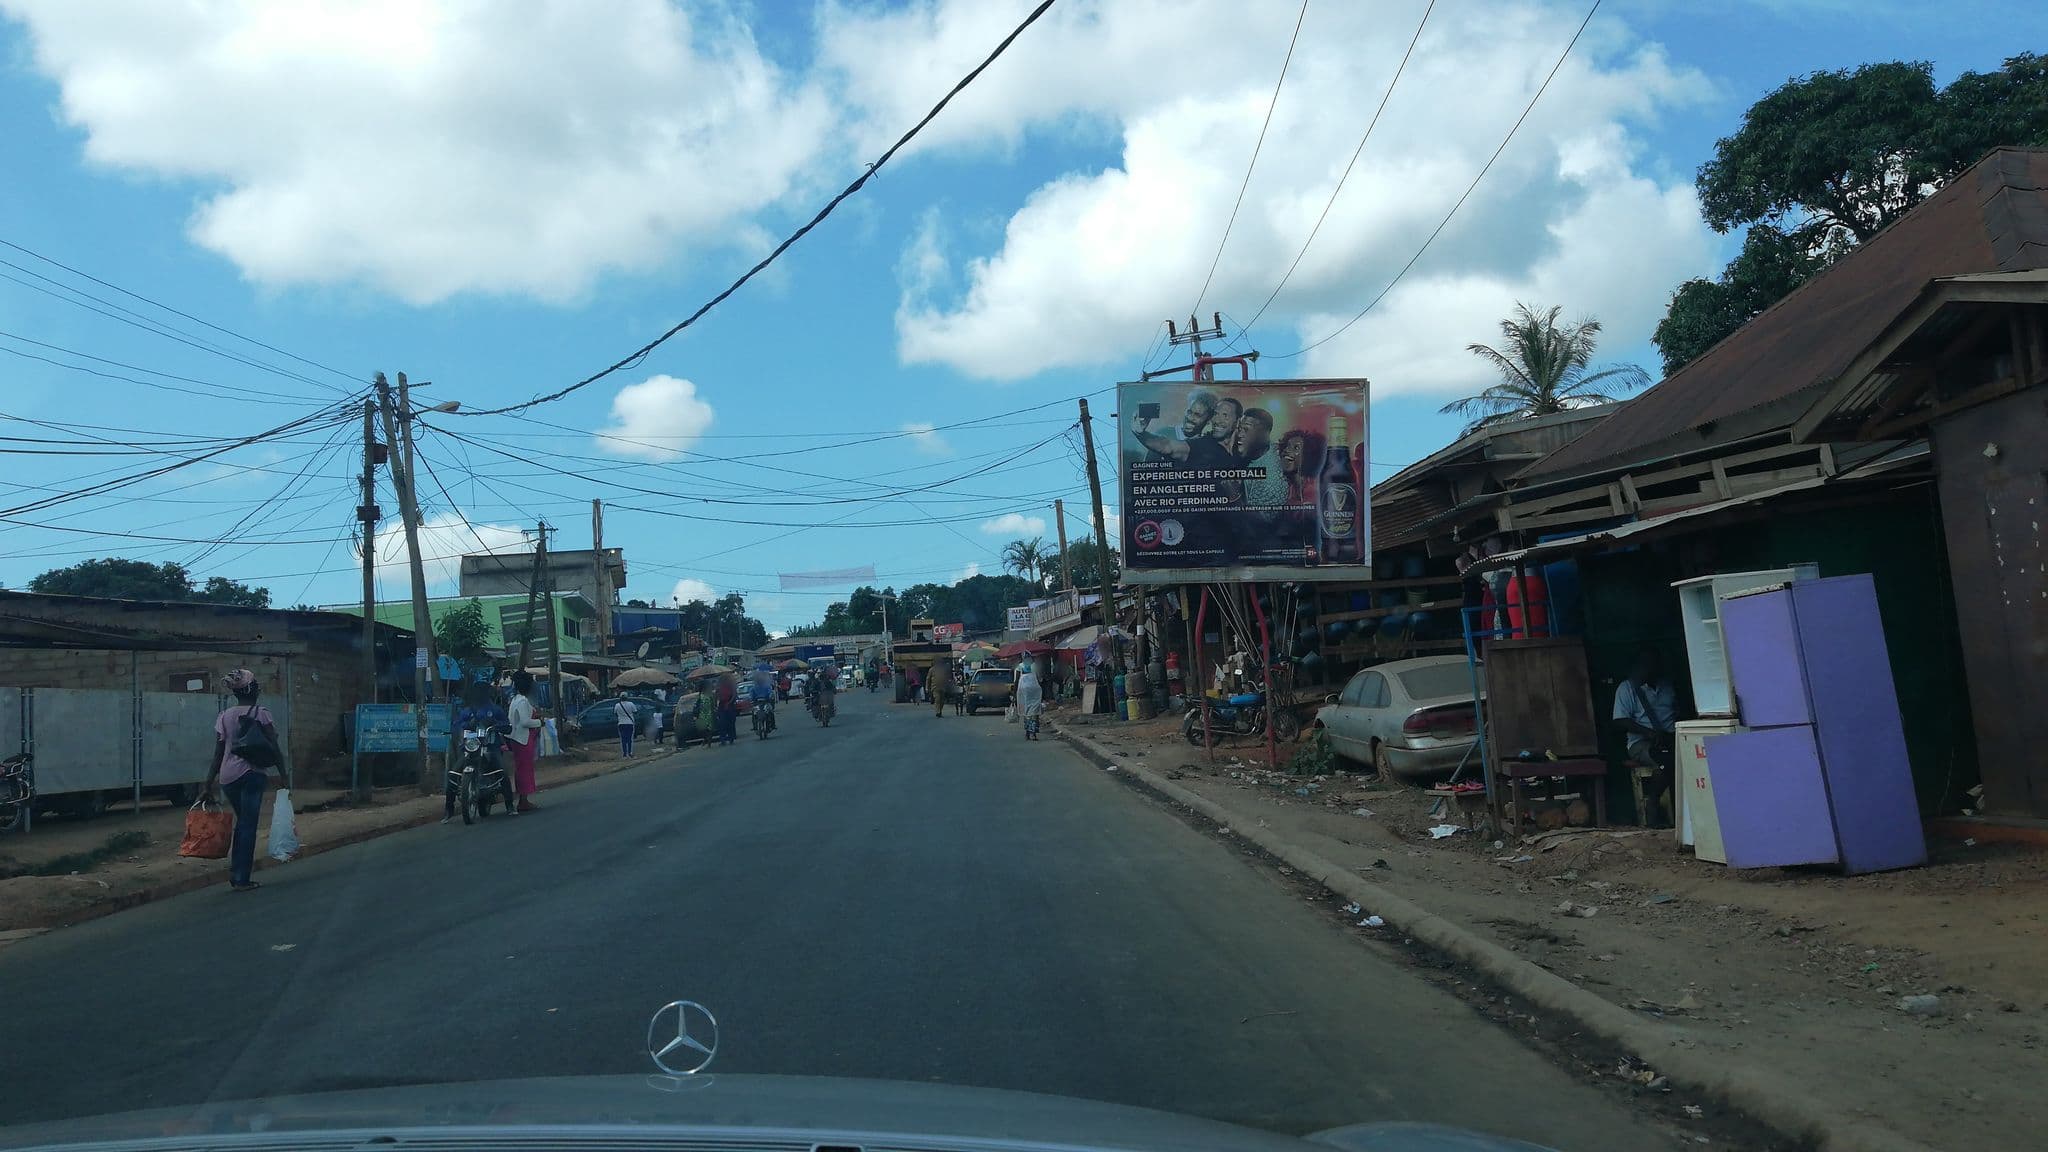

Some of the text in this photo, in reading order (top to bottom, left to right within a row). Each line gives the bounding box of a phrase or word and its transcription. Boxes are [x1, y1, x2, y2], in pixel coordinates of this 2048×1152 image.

[1132, 469, 1266, 481] EXPERIENCE DE FOOTBALL
[1133, 484, 1216, 495] EN ANGLETERRE
[1134, 496, 1229, 507] AVEC RIO FERDINAND
